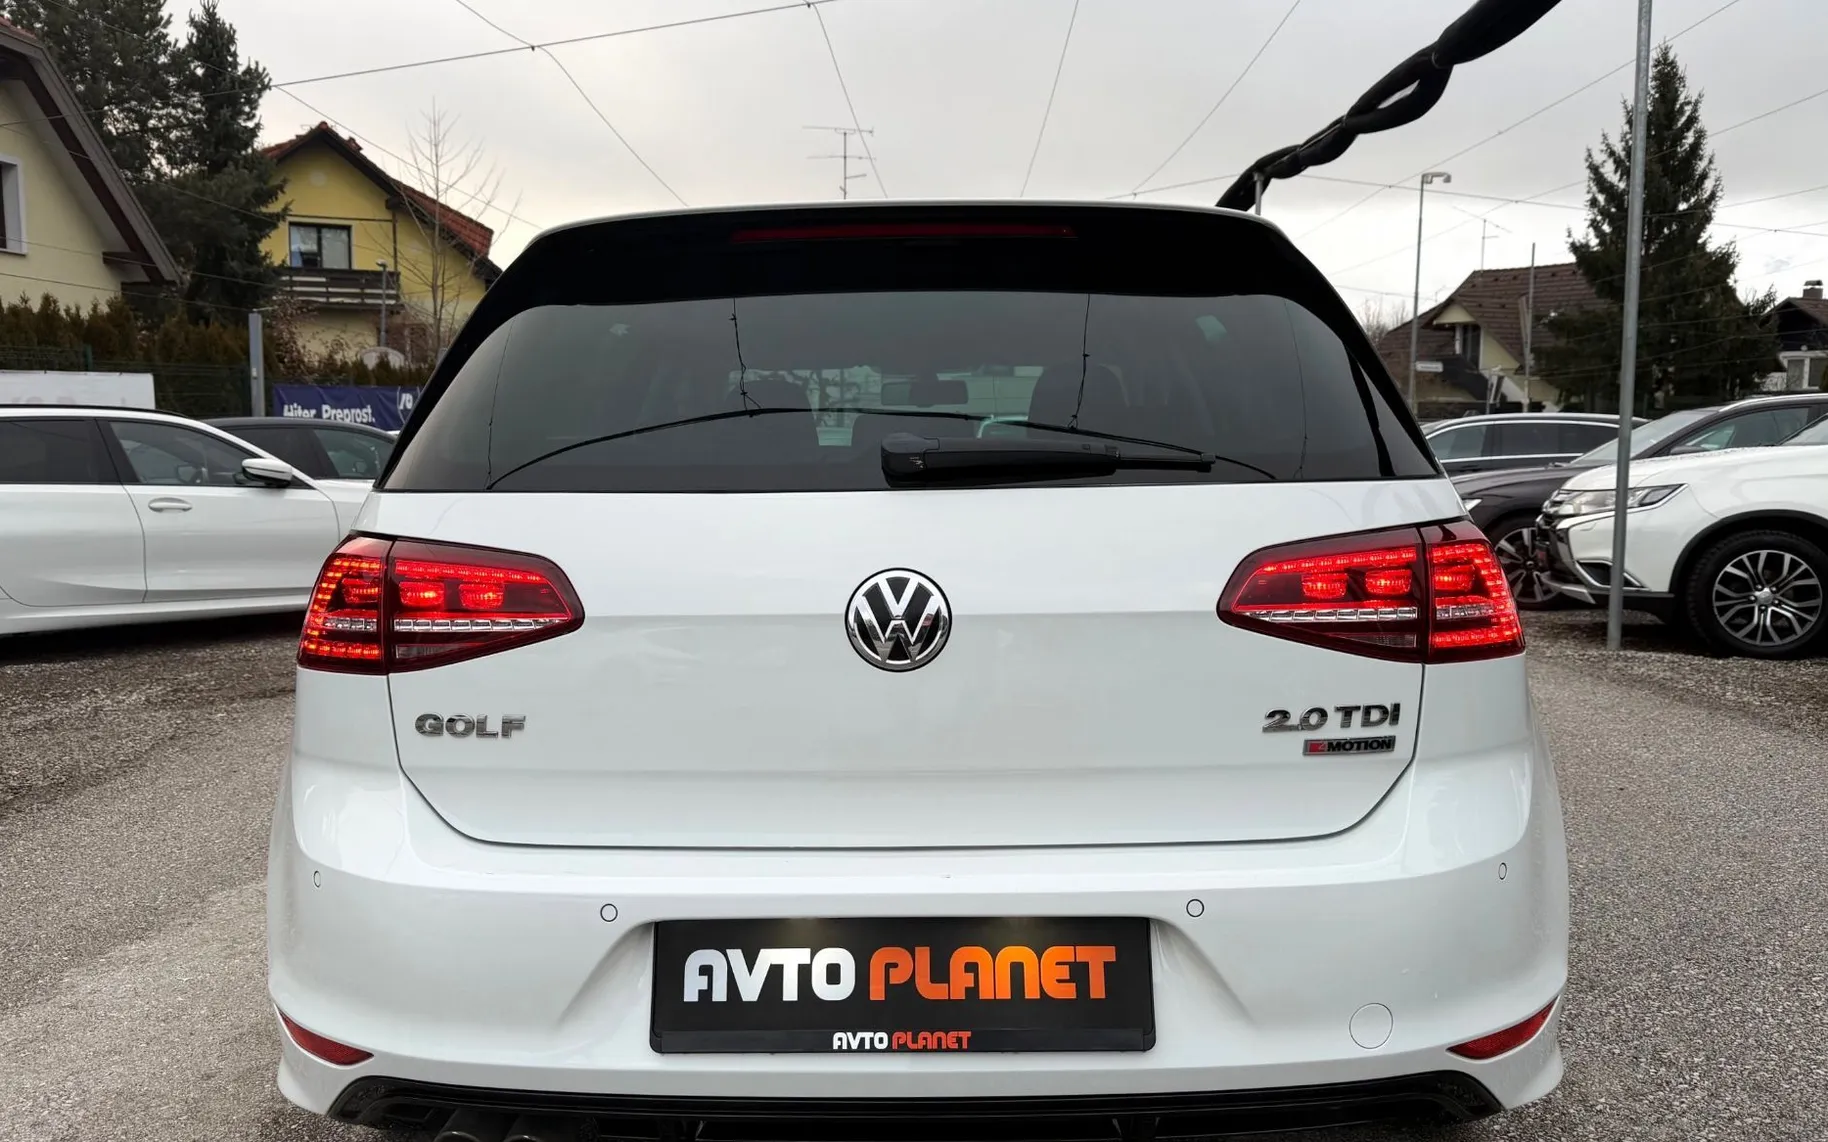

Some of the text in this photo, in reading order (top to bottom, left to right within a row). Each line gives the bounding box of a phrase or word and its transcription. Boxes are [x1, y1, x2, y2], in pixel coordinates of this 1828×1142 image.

[415, 713, 526, 738] GOLF
[1262, 703, 1401, 732] 2.0 TDI
[684, 946, 1116, 1002] AVTO PLANET
[833, 1031, 972, 1050] AVTO PLANET
